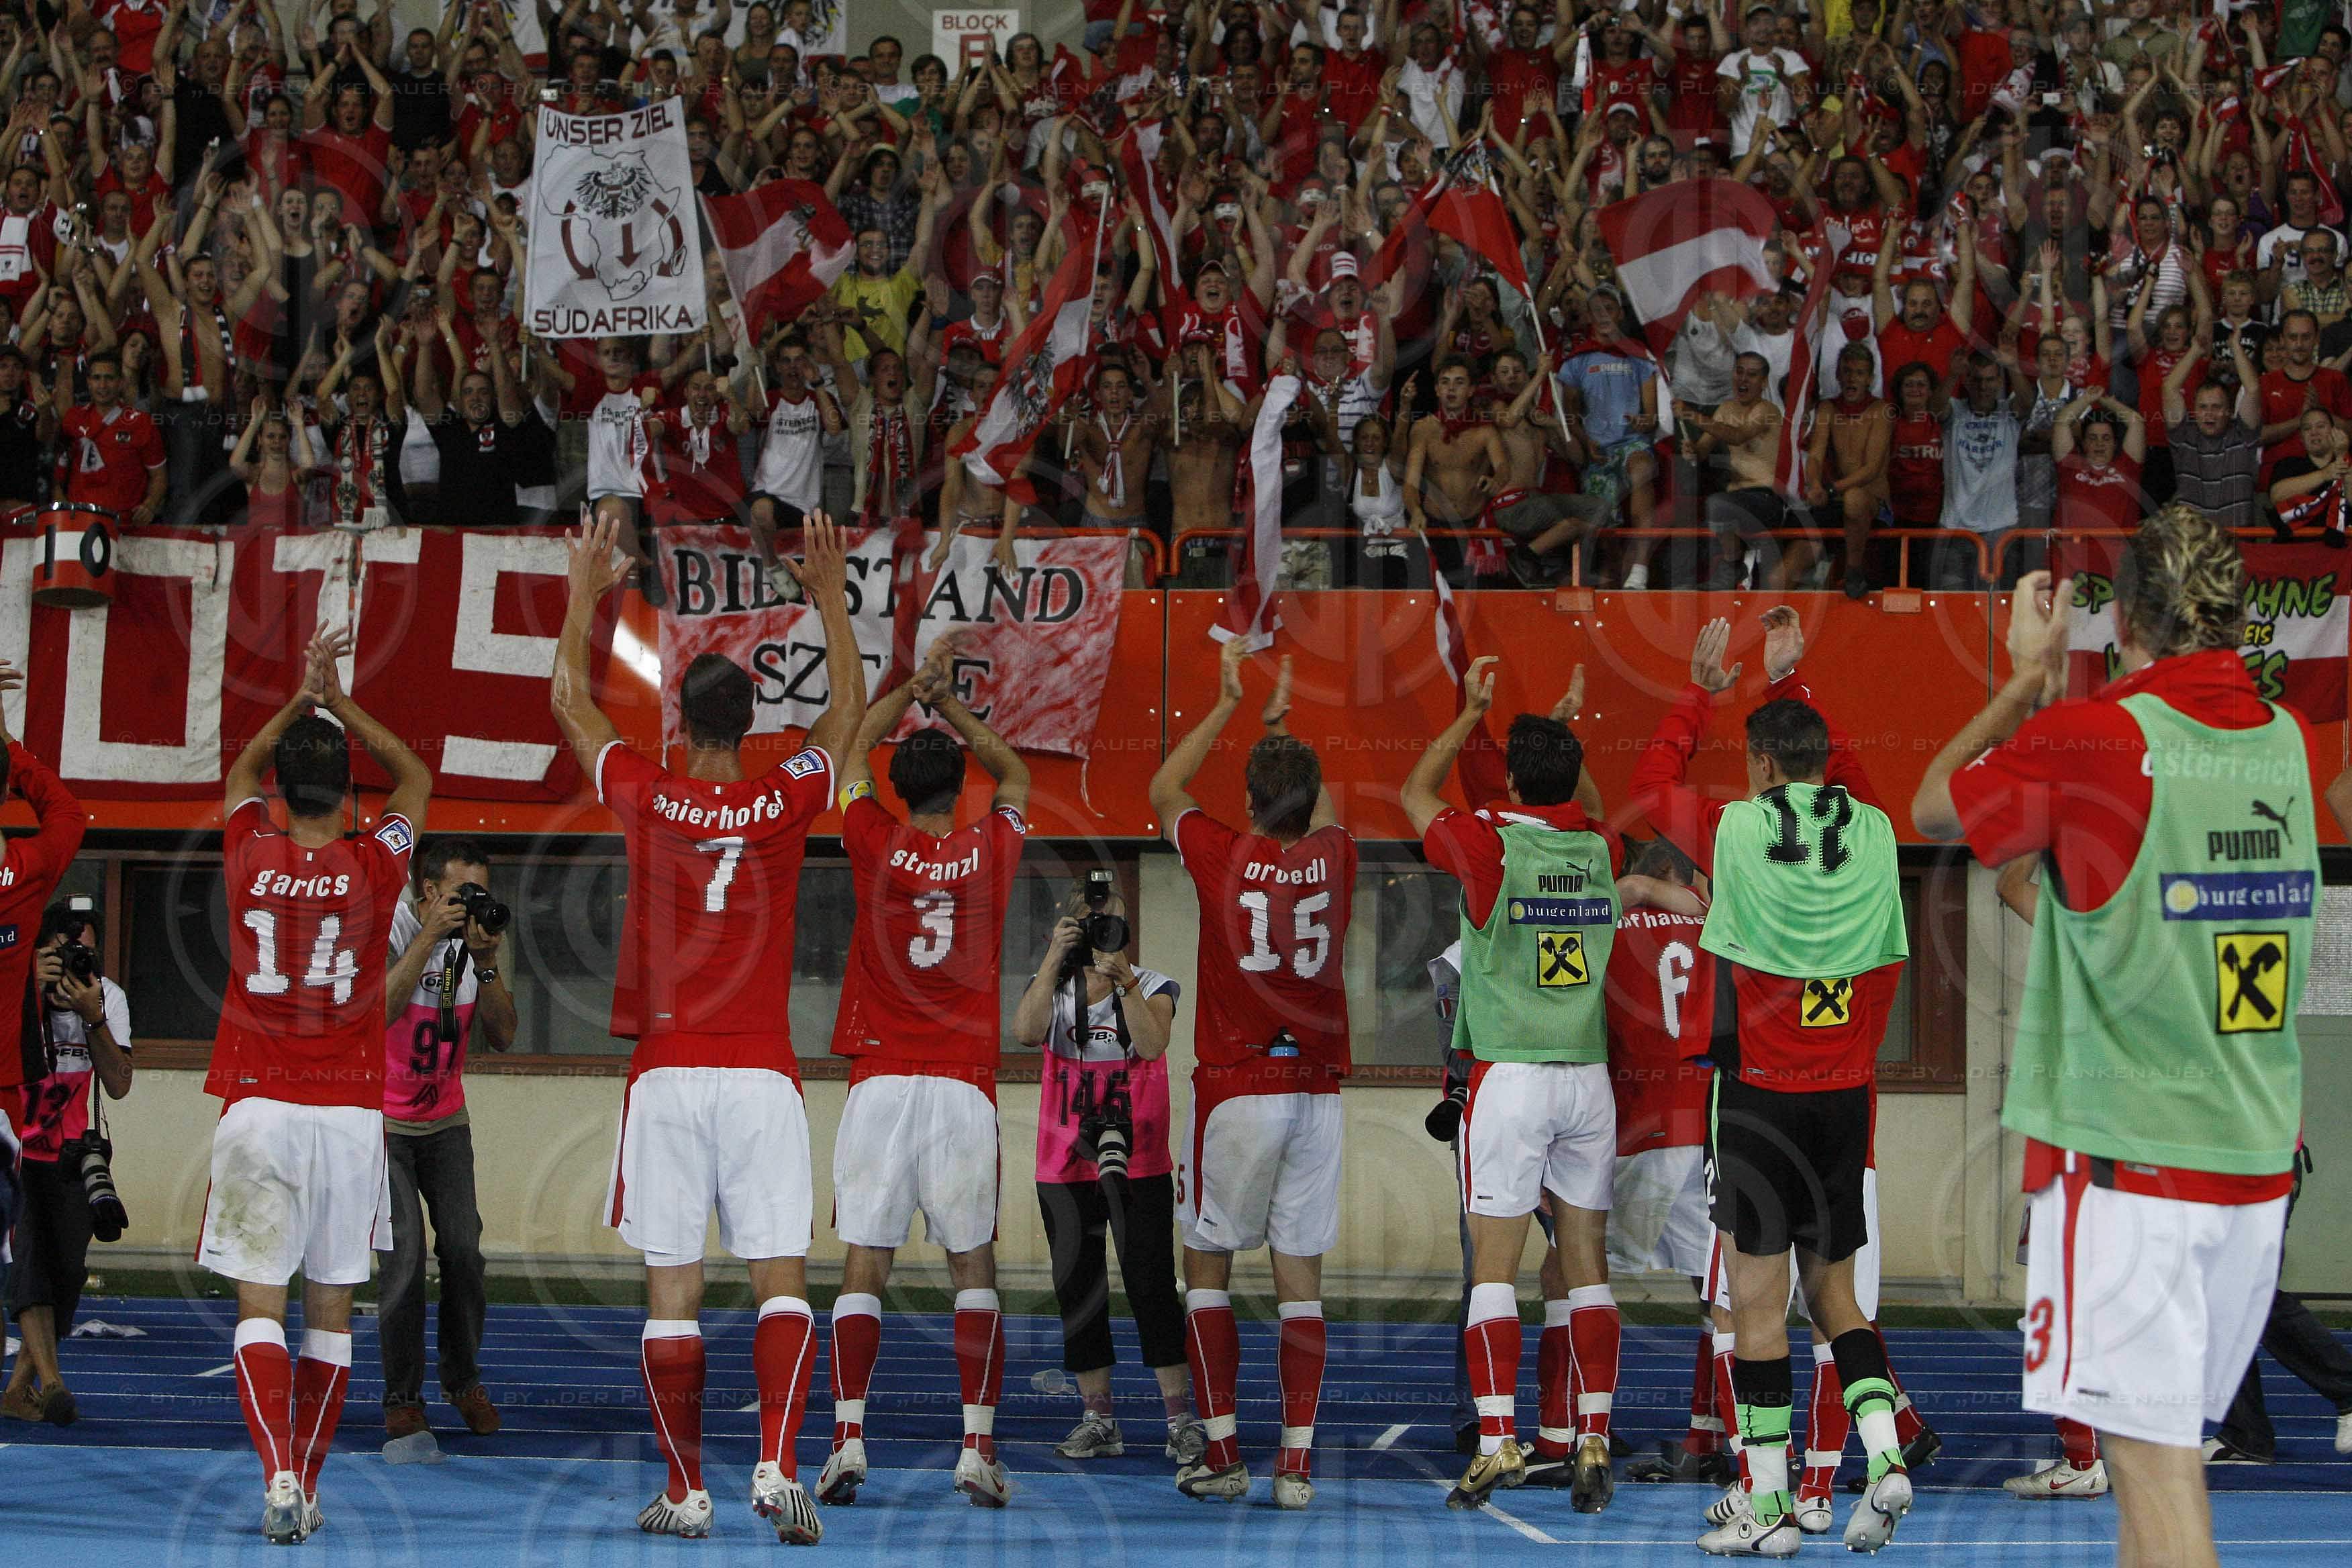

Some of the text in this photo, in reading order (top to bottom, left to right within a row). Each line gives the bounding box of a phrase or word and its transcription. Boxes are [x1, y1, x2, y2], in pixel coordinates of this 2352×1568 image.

[942, 14, 1008, 31] BLOCK
[545, 104, 674, 145] UNSER ZIEL
[534, 304, 694, 335] SÜDAFRIKA
[45, 522, 111, 581] 10
[673, 549, 1085, 622] BIESTAND
[2208, 830, 2280, 860] PUMA
[695, 836, 747, 913] 7
[889, 847, 979, 881] stranzl
[250, 869, 350, 897] garics
[1537, 875, 1583, 893] PUMA
[908, 887, 957, 969] 3
[1527, 903, 1610, 918] burgenland
[1237, 889, 1331, 979] 15
[243, 908, 361, 1006] 14
